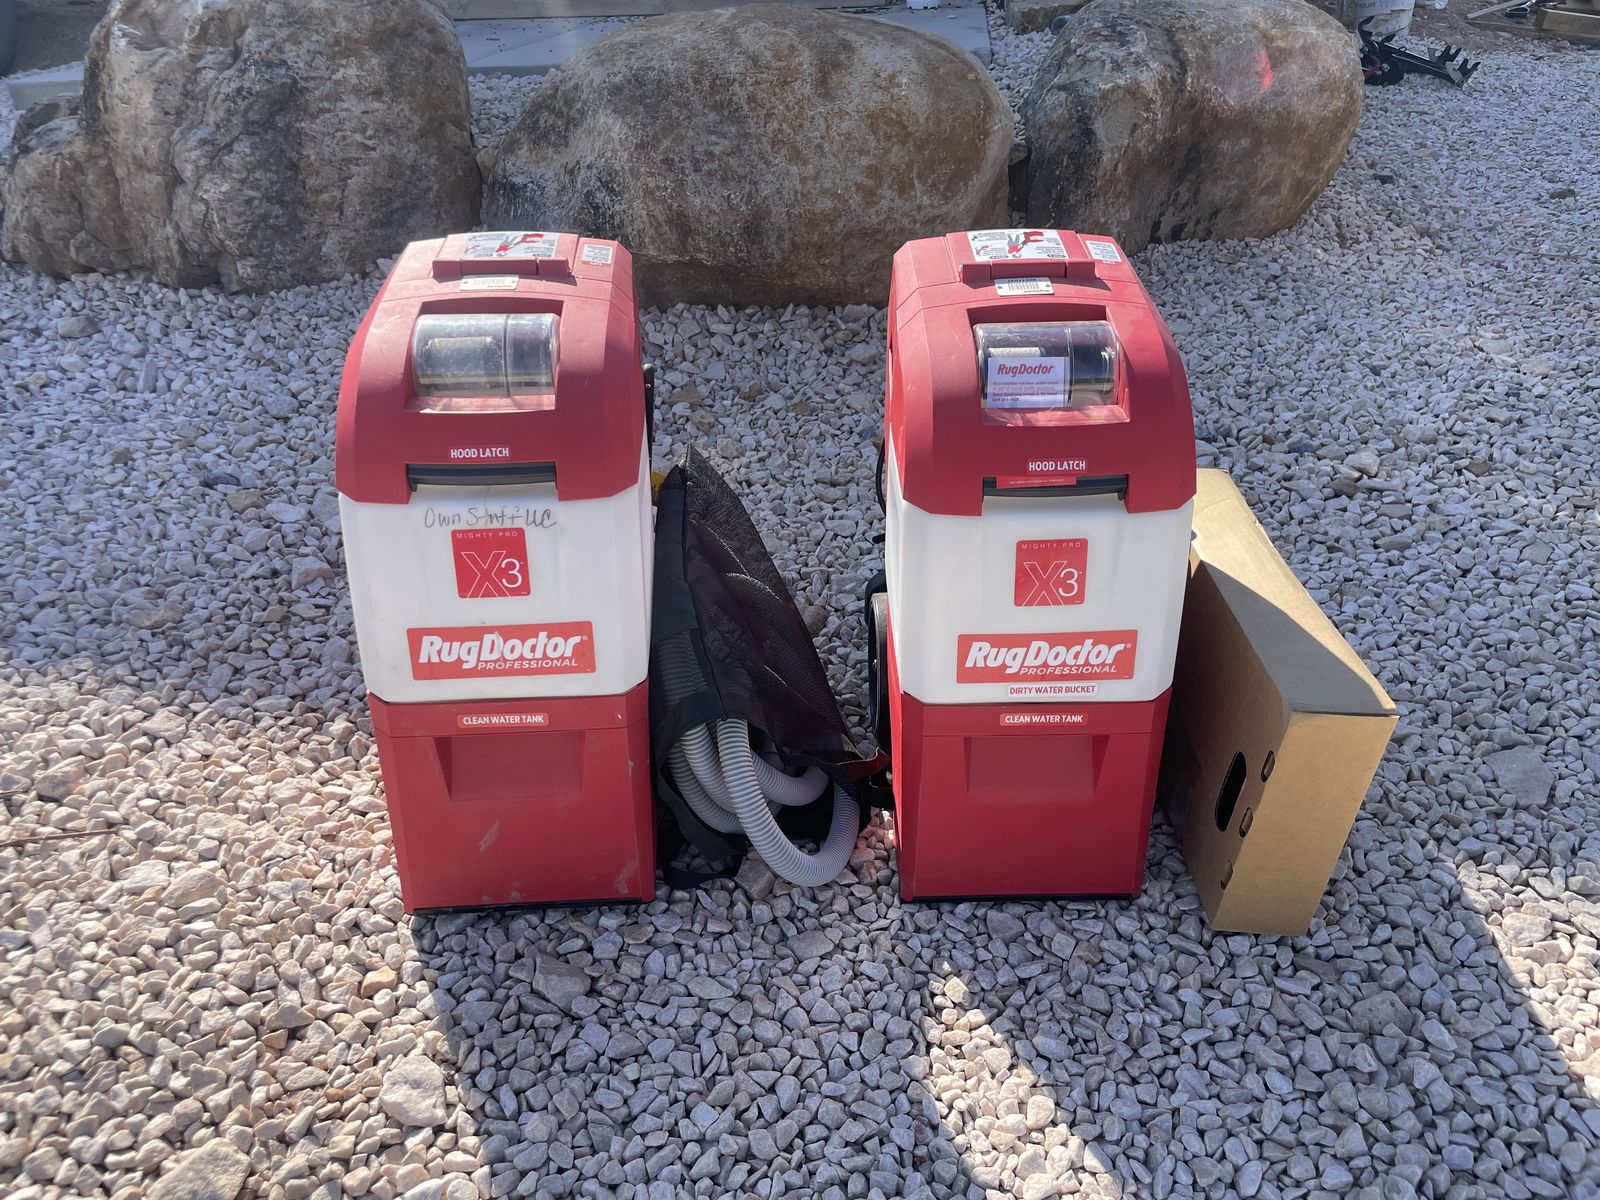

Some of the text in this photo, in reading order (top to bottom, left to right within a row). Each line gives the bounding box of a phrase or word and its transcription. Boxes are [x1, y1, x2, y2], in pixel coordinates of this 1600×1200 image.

[997, 363, 1054, 377] RugDoctor
[450, 448, 509, 459] HOOD LATCH
[1029, 460, 1086, 471] HOOD LATCH
[424, 506, 461, 529] Own
[461, 550, 523, 598] X3
[1023, 560, 1079, 606] X3
[418, 631, 582, 669] RugDoctor
[964, 639, 1126, 674] RugDoctor
[477, 658, 578, 670] PROFESSIONAL
[1020, 665, 1117, 676] PROFESSIONAL
[1009, 685, 1096, 695] DIRTY WATER BUCKET
[463, 714, 544, 725] CLEAN WATER TANK
[1005, 714, 1083, 723] CLEAN WATER TANK
